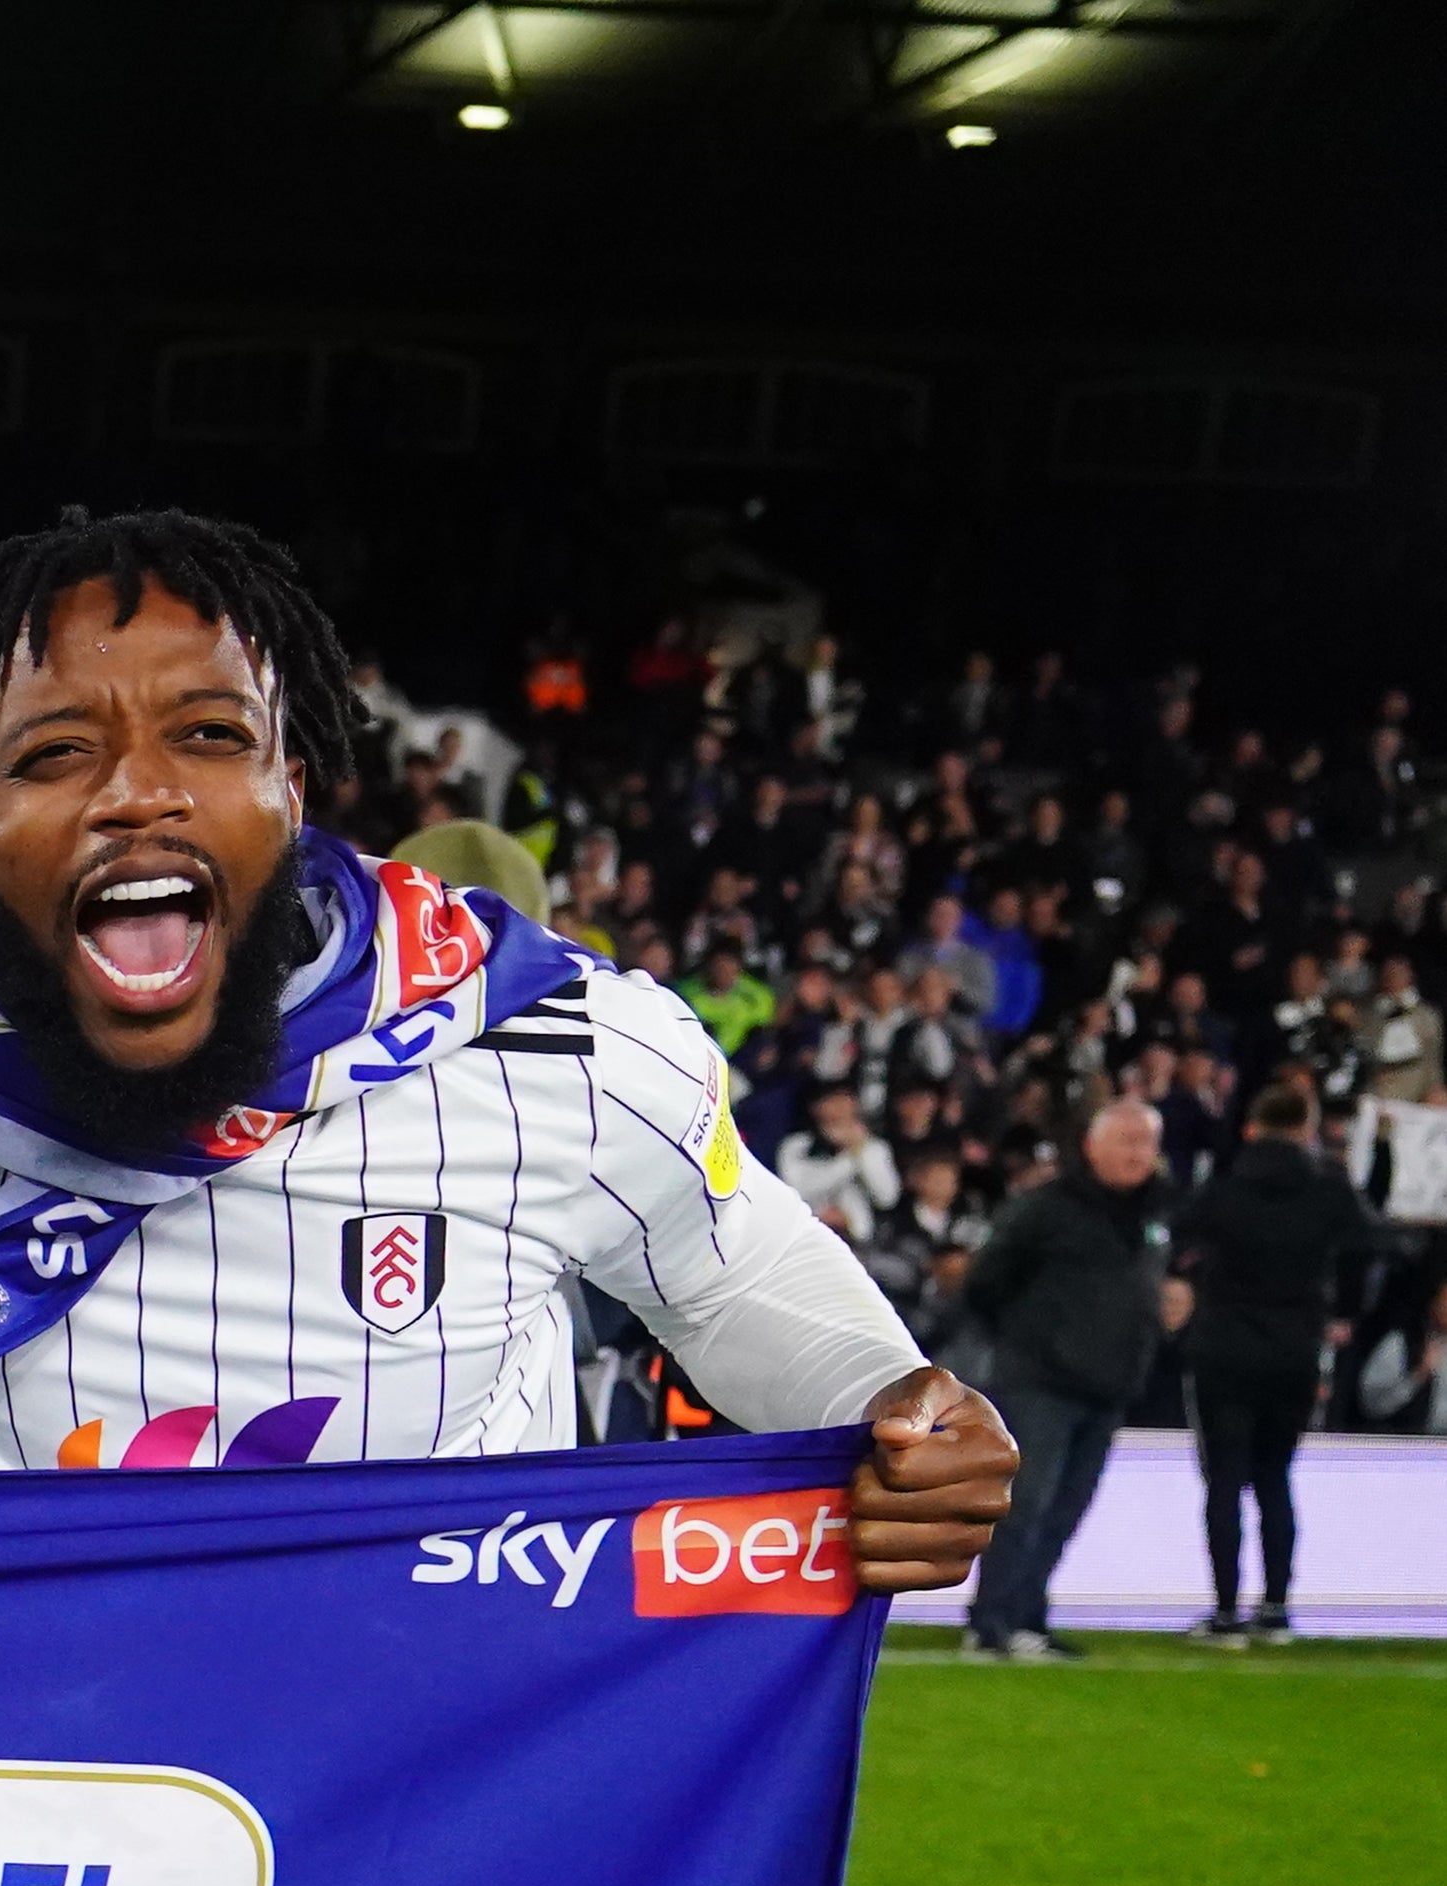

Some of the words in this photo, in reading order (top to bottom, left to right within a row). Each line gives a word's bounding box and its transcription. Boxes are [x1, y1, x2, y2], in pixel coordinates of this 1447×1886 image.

[369, 1225, 419, 1309] FFC
[411, 1510, 618, 1609] sky
[660, 1505, 848, 1586] bet
